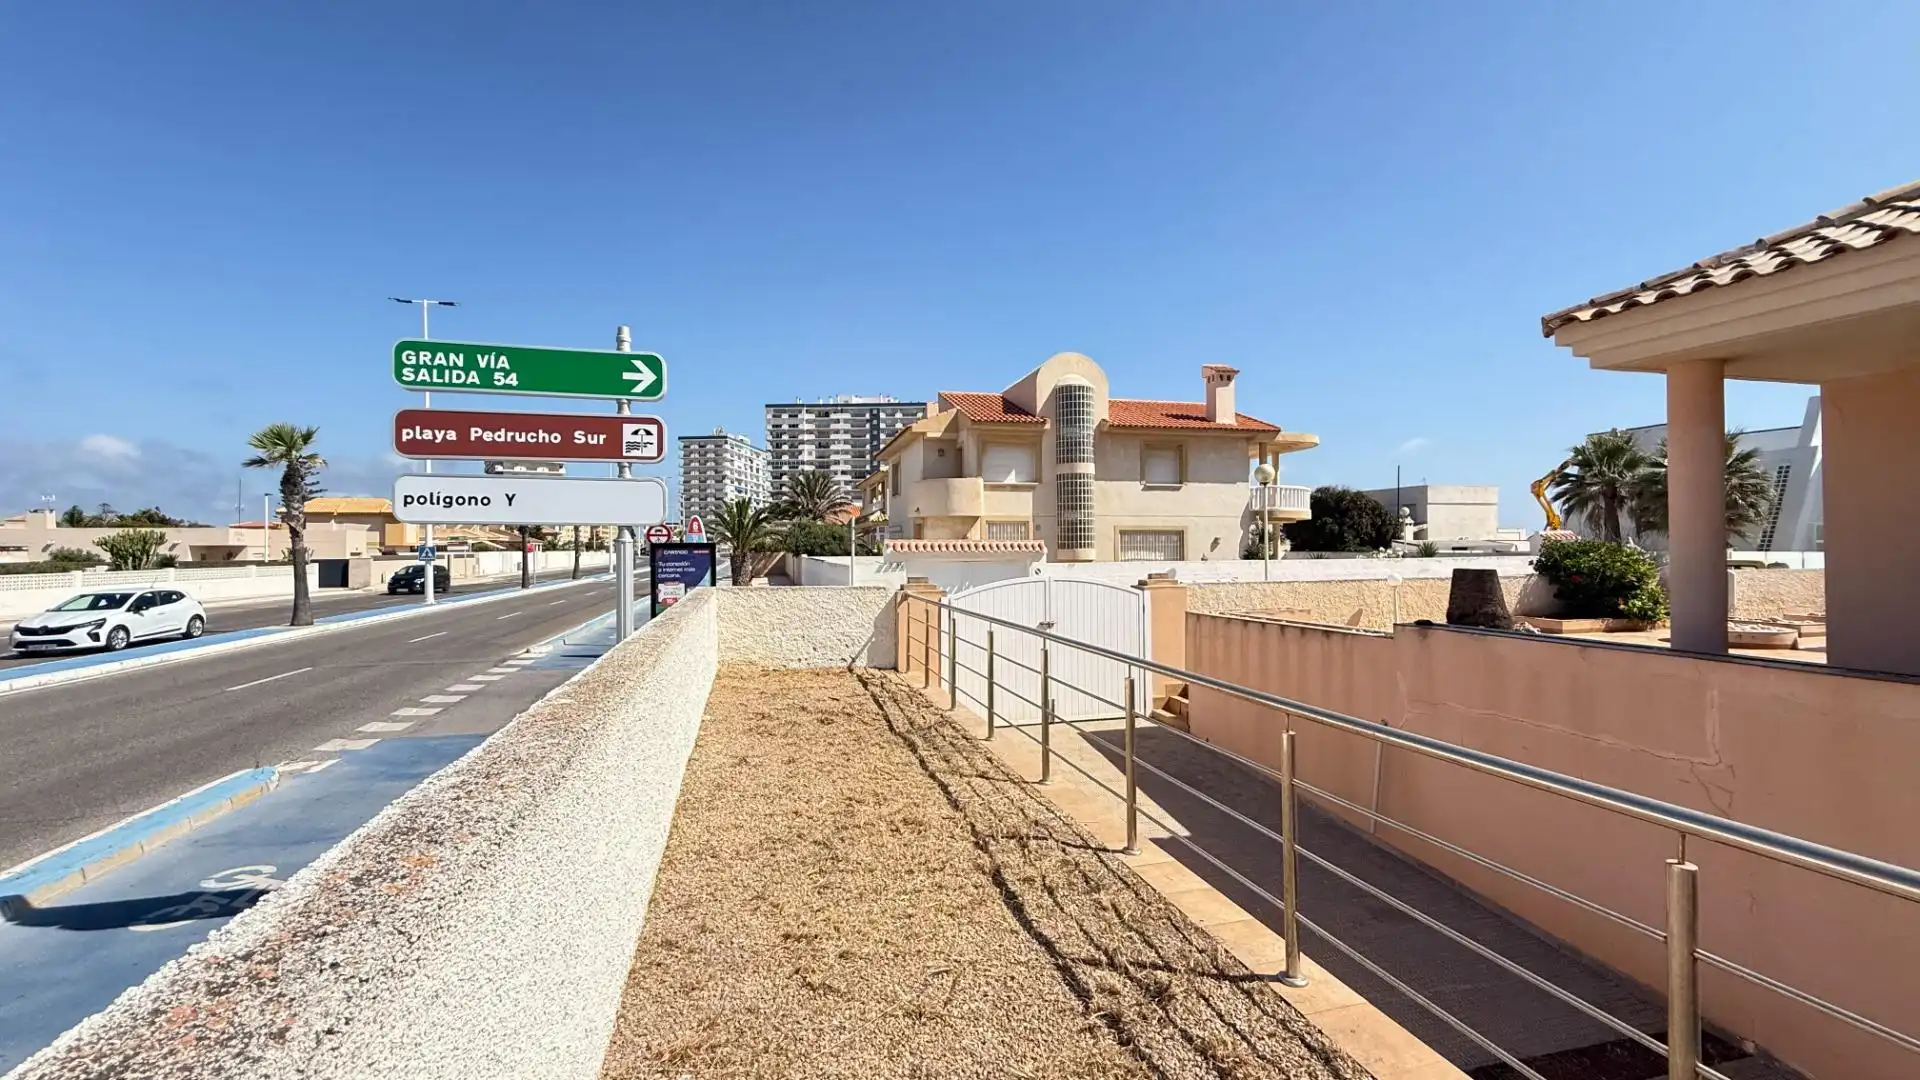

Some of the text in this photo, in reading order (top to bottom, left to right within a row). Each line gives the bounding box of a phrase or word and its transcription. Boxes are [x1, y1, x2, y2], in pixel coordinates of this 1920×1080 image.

[401, 350, 510, 369] GRAN VÍA
[401, 367, 519, 387] SALIDA 54
[401, 425, 607, 445] playa Pedrucho Sur
[403, 490, 517, 509] polígono Y
